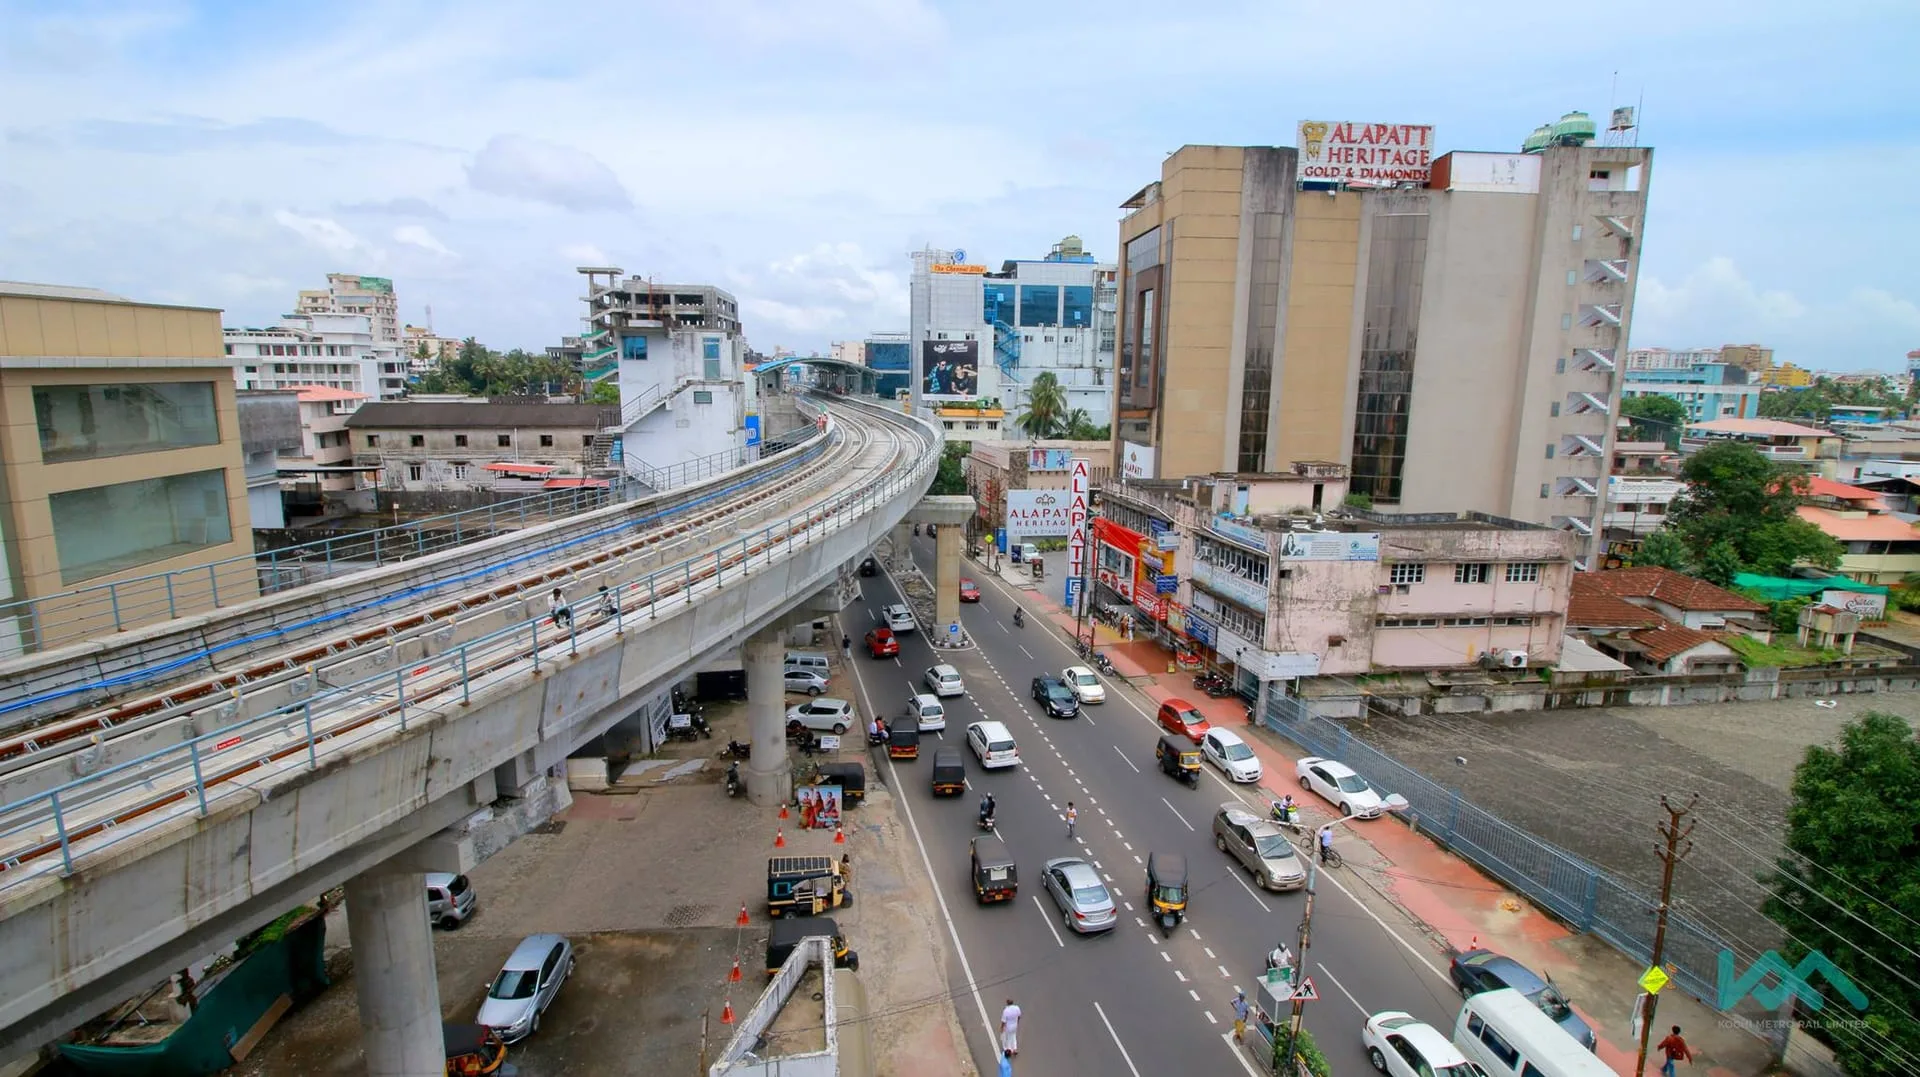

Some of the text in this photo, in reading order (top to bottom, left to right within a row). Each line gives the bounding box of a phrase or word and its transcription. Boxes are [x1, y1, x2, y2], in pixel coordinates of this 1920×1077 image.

[1329, 123, 1432, 146] ALAPATT
[1328, 147, 1430, 166] HERITAGE
[1305, 166, 1429, 182] GOLD & DIAMONDS
[1071, 462, 1087, 576] ALAPATT
